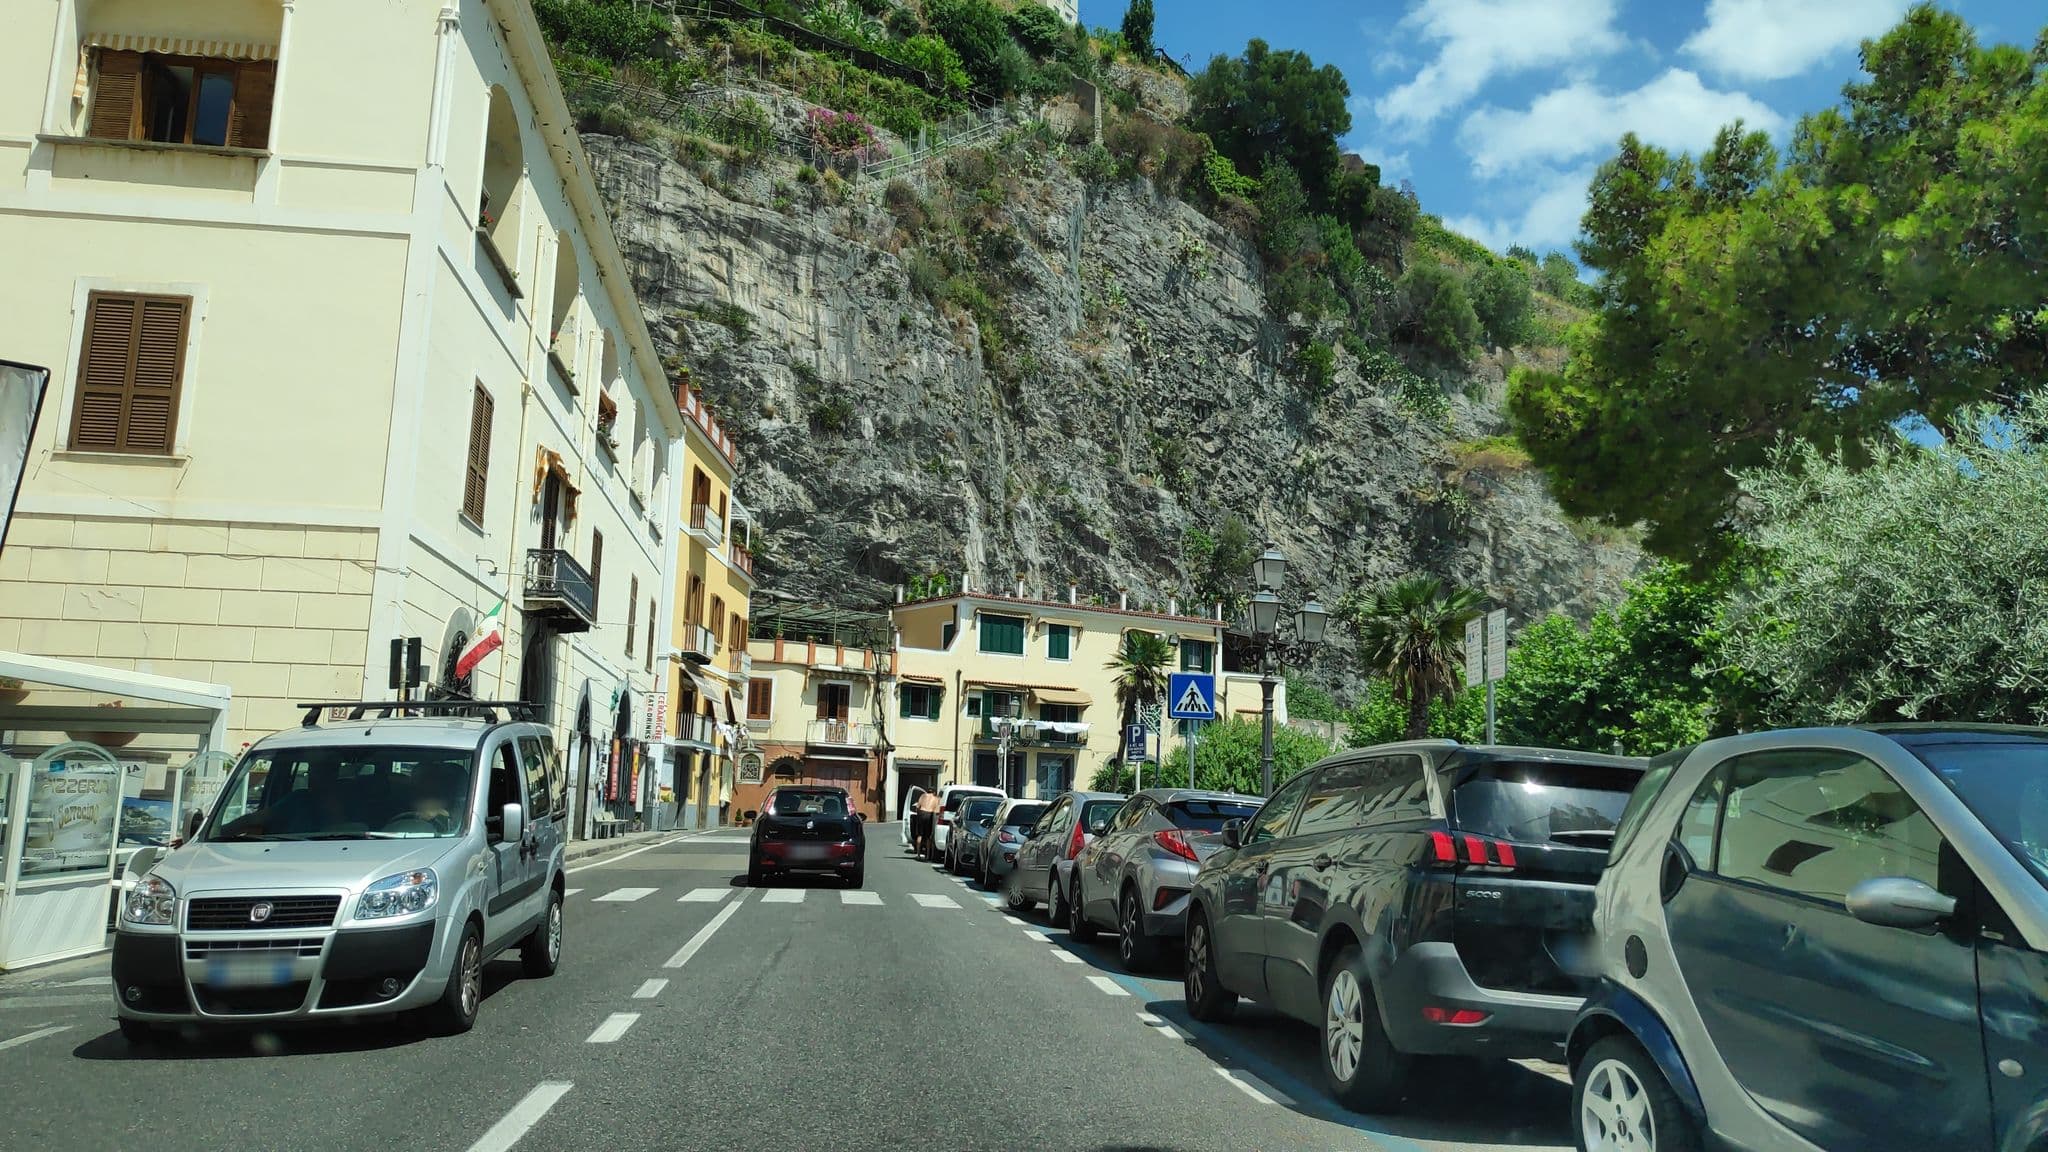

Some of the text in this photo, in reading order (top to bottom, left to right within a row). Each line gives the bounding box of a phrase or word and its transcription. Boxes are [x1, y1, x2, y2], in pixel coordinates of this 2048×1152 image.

[332, 706, 346, 718] 32
[655, 695, 665, 740] CERAMICHE
[1132, 726, 1141, 743] P
